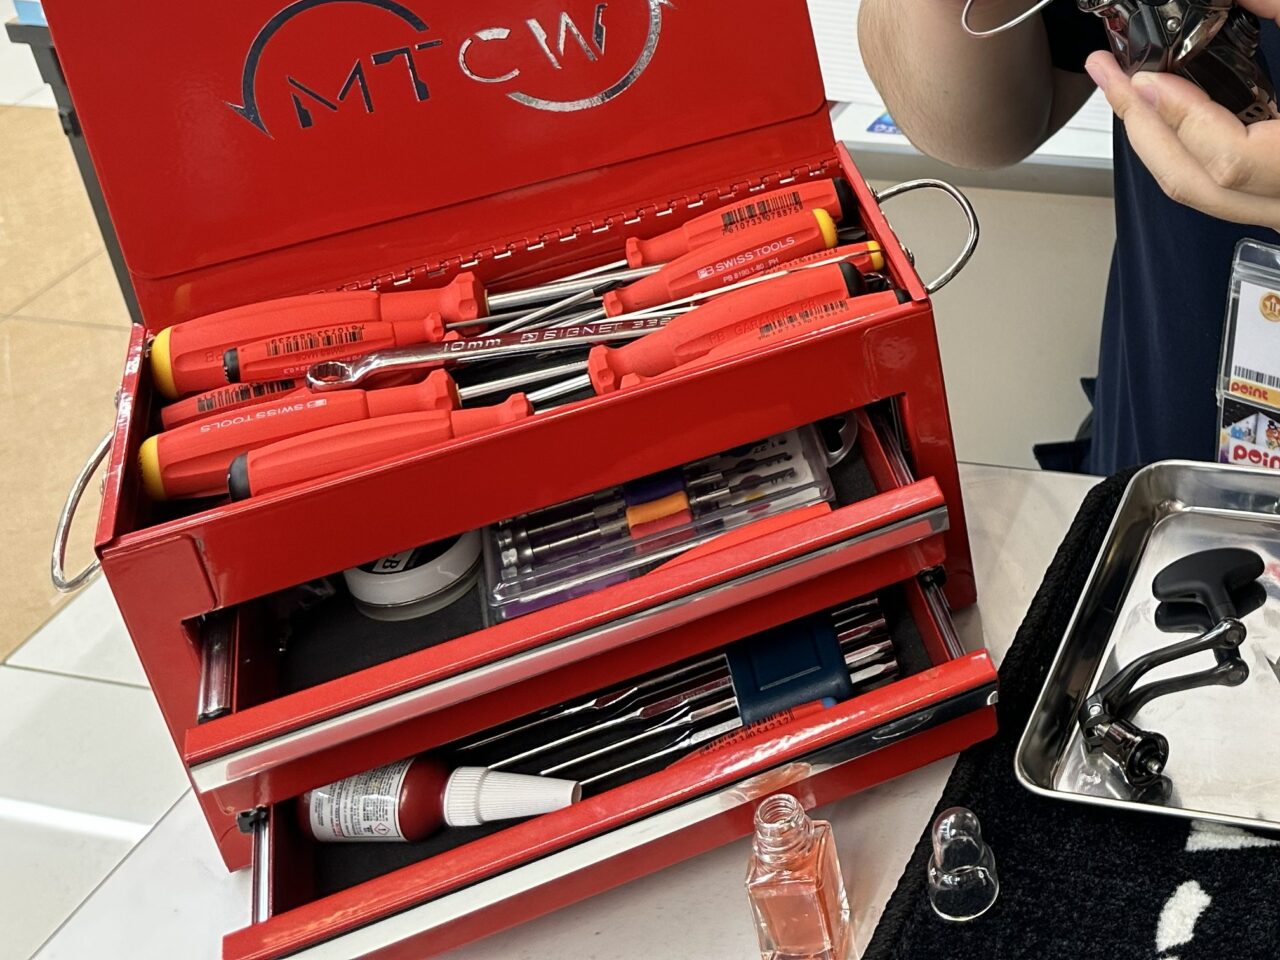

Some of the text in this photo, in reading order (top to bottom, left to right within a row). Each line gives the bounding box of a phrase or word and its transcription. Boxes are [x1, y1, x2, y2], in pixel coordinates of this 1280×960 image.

[716, 251, 754, 272] SWISS
[755, 236, 796, 257] TOOLS
[443, 337, 502, 353] 10mm
[543, 322, 623, 340] SIGNET
[1231, 381, 1269, 401] point
[255, 402, 304, 419] SWISS
[200, 415, 256, 433] TOOLS
